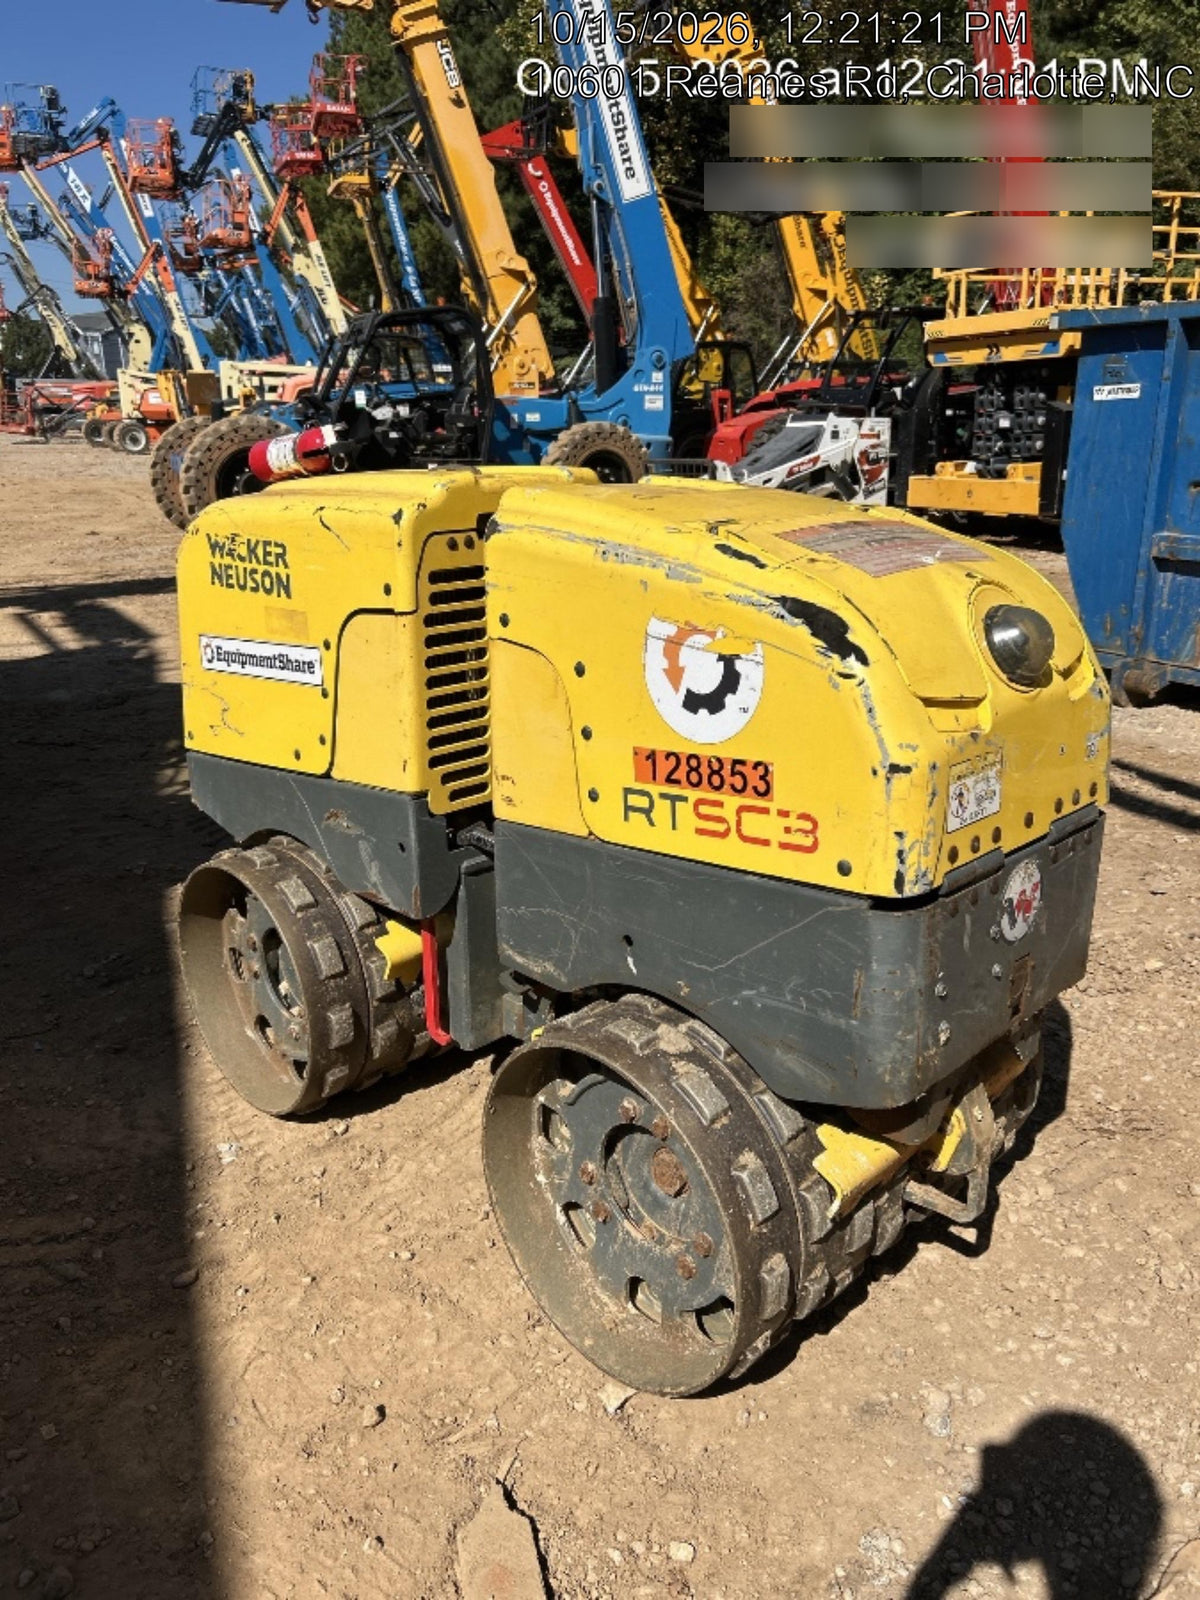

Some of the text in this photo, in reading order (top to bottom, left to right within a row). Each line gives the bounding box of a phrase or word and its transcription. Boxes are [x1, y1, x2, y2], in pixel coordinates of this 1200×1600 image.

[436, 40, 460, 87] JCB
[209, 561, 292, 599] NEUSON
[215, 645, 316, 675] EquipmentShare
[645, 750, 771, 798] 128853
